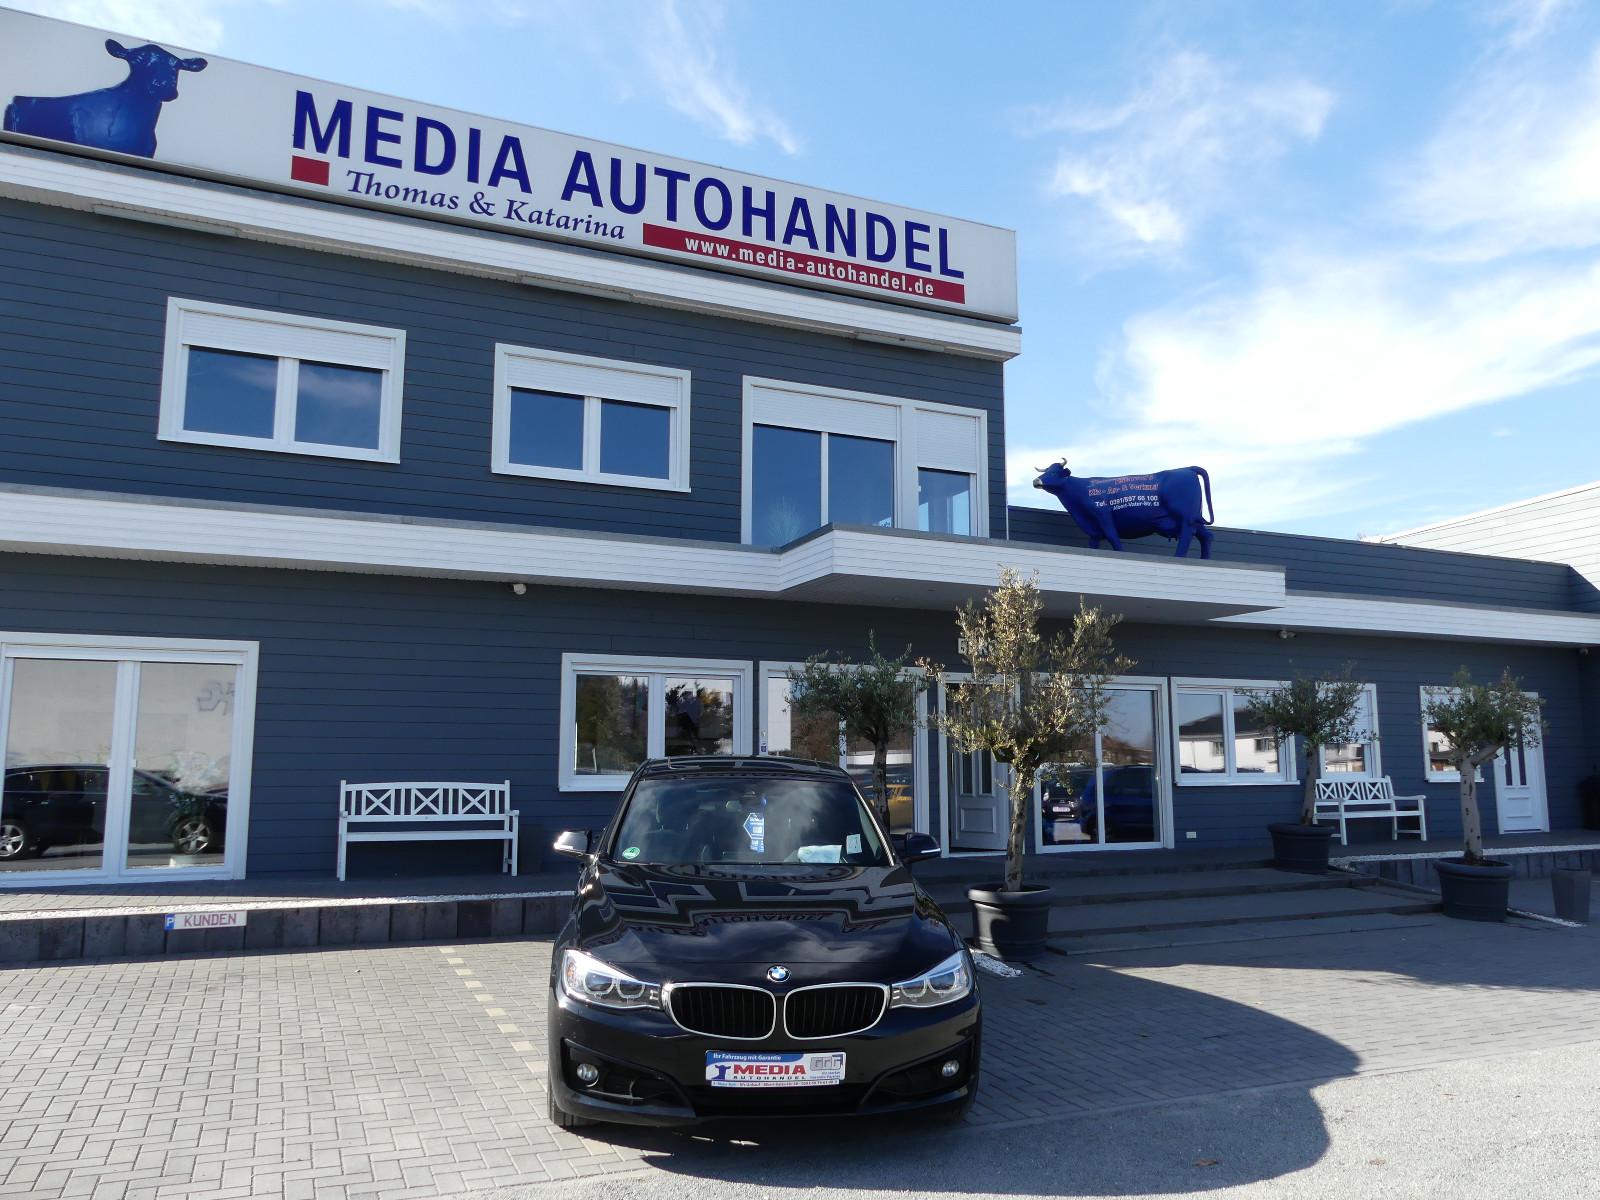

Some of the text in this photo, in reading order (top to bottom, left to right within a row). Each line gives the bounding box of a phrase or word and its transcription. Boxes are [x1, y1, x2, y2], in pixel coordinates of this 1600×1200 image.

[293, 90, 965, 279] MEDIA AUTOHANDEL
[346, 169, 625, 240] Thomas & Katarina
[685, 237, 934, 297] www.media-autohandel.de
[184, 913, 237, 927] KUNDEN
[733, 1064, 807, 1075] MEDIA
